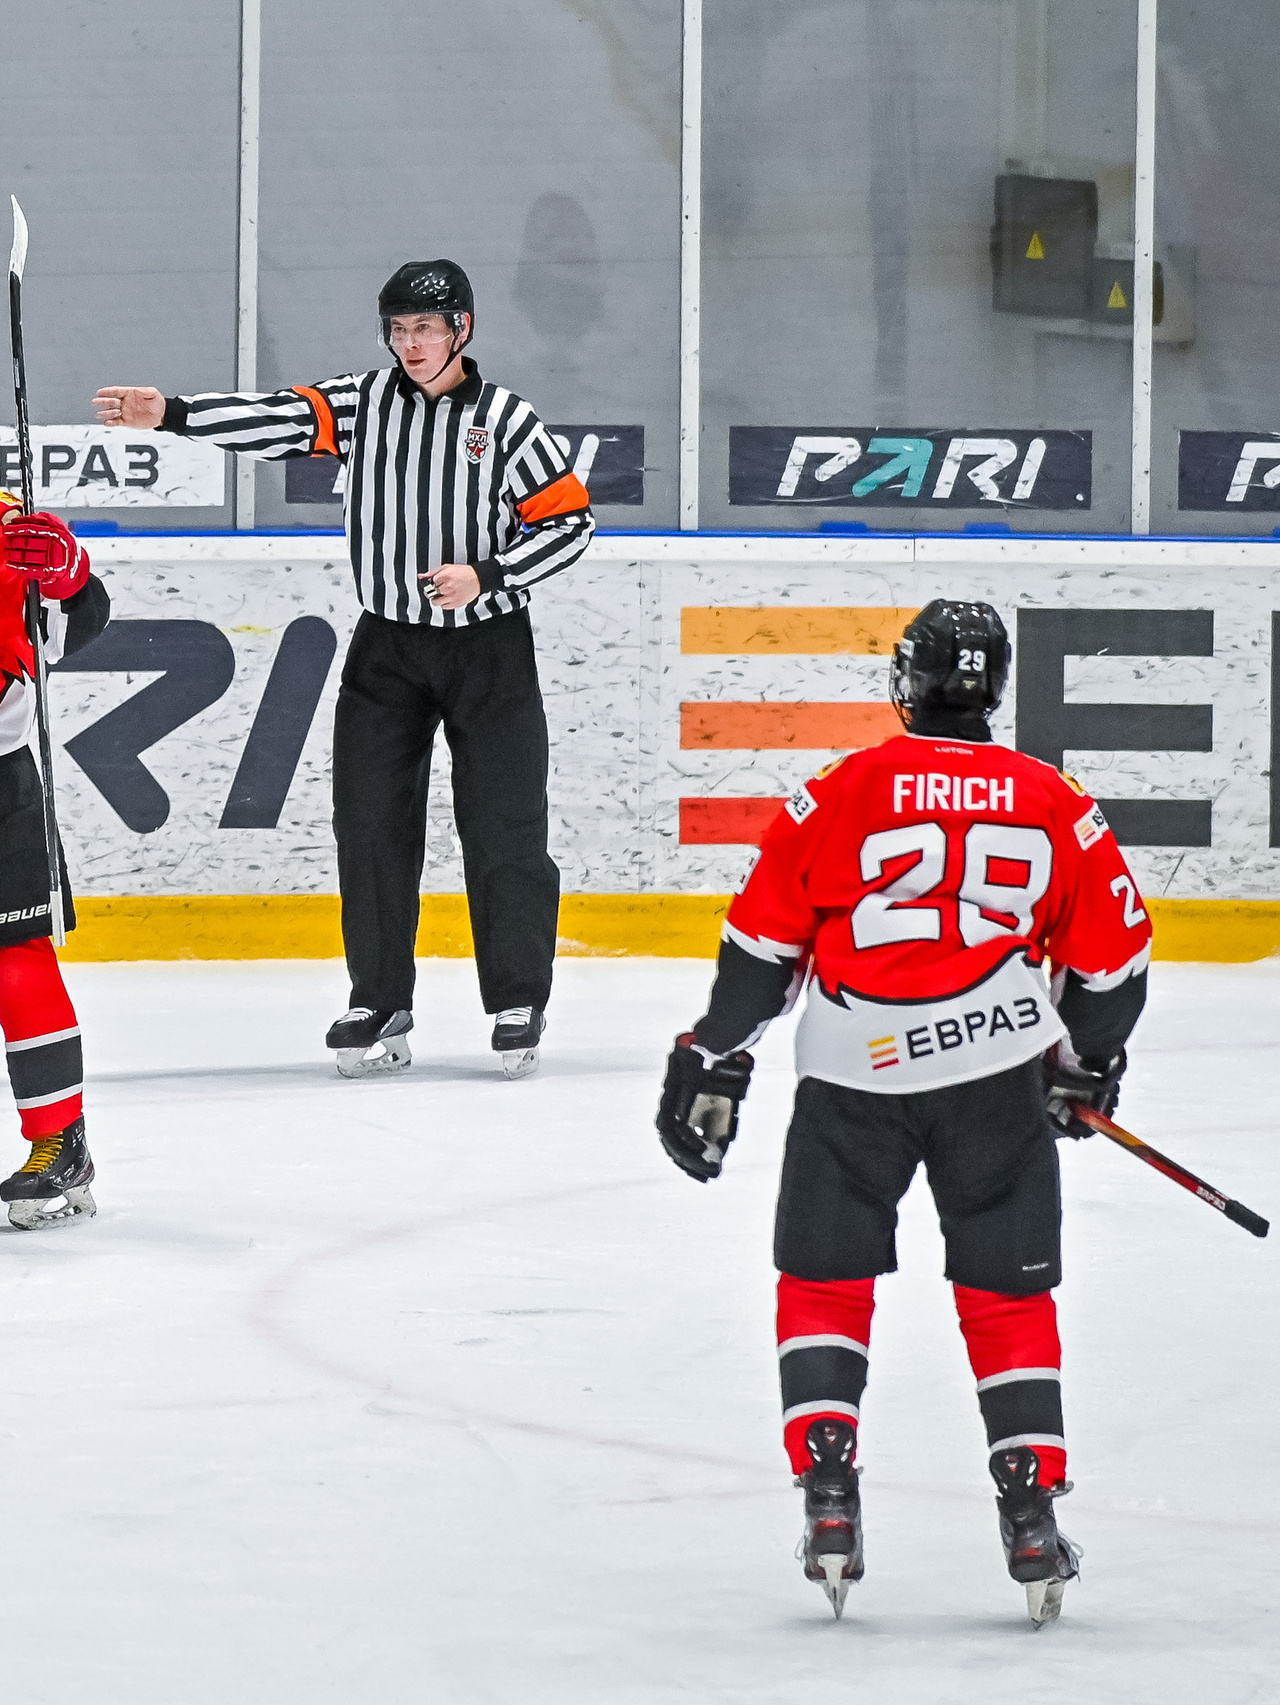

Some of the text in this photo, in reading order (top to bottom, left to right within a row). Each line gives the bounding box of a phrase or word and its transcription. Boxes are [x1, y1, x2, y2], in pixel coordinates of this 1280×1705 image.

[468, 433, 487, 443] МХЛ
[776, 436, 1047, 500] PARI
[957, 648, 987, 672] 29
[893, 772, 1015, 814] FIRICH
[1109, 873, 1147, 930] 2
[905, 996, 1042, 1060] ЕВРАЗ
